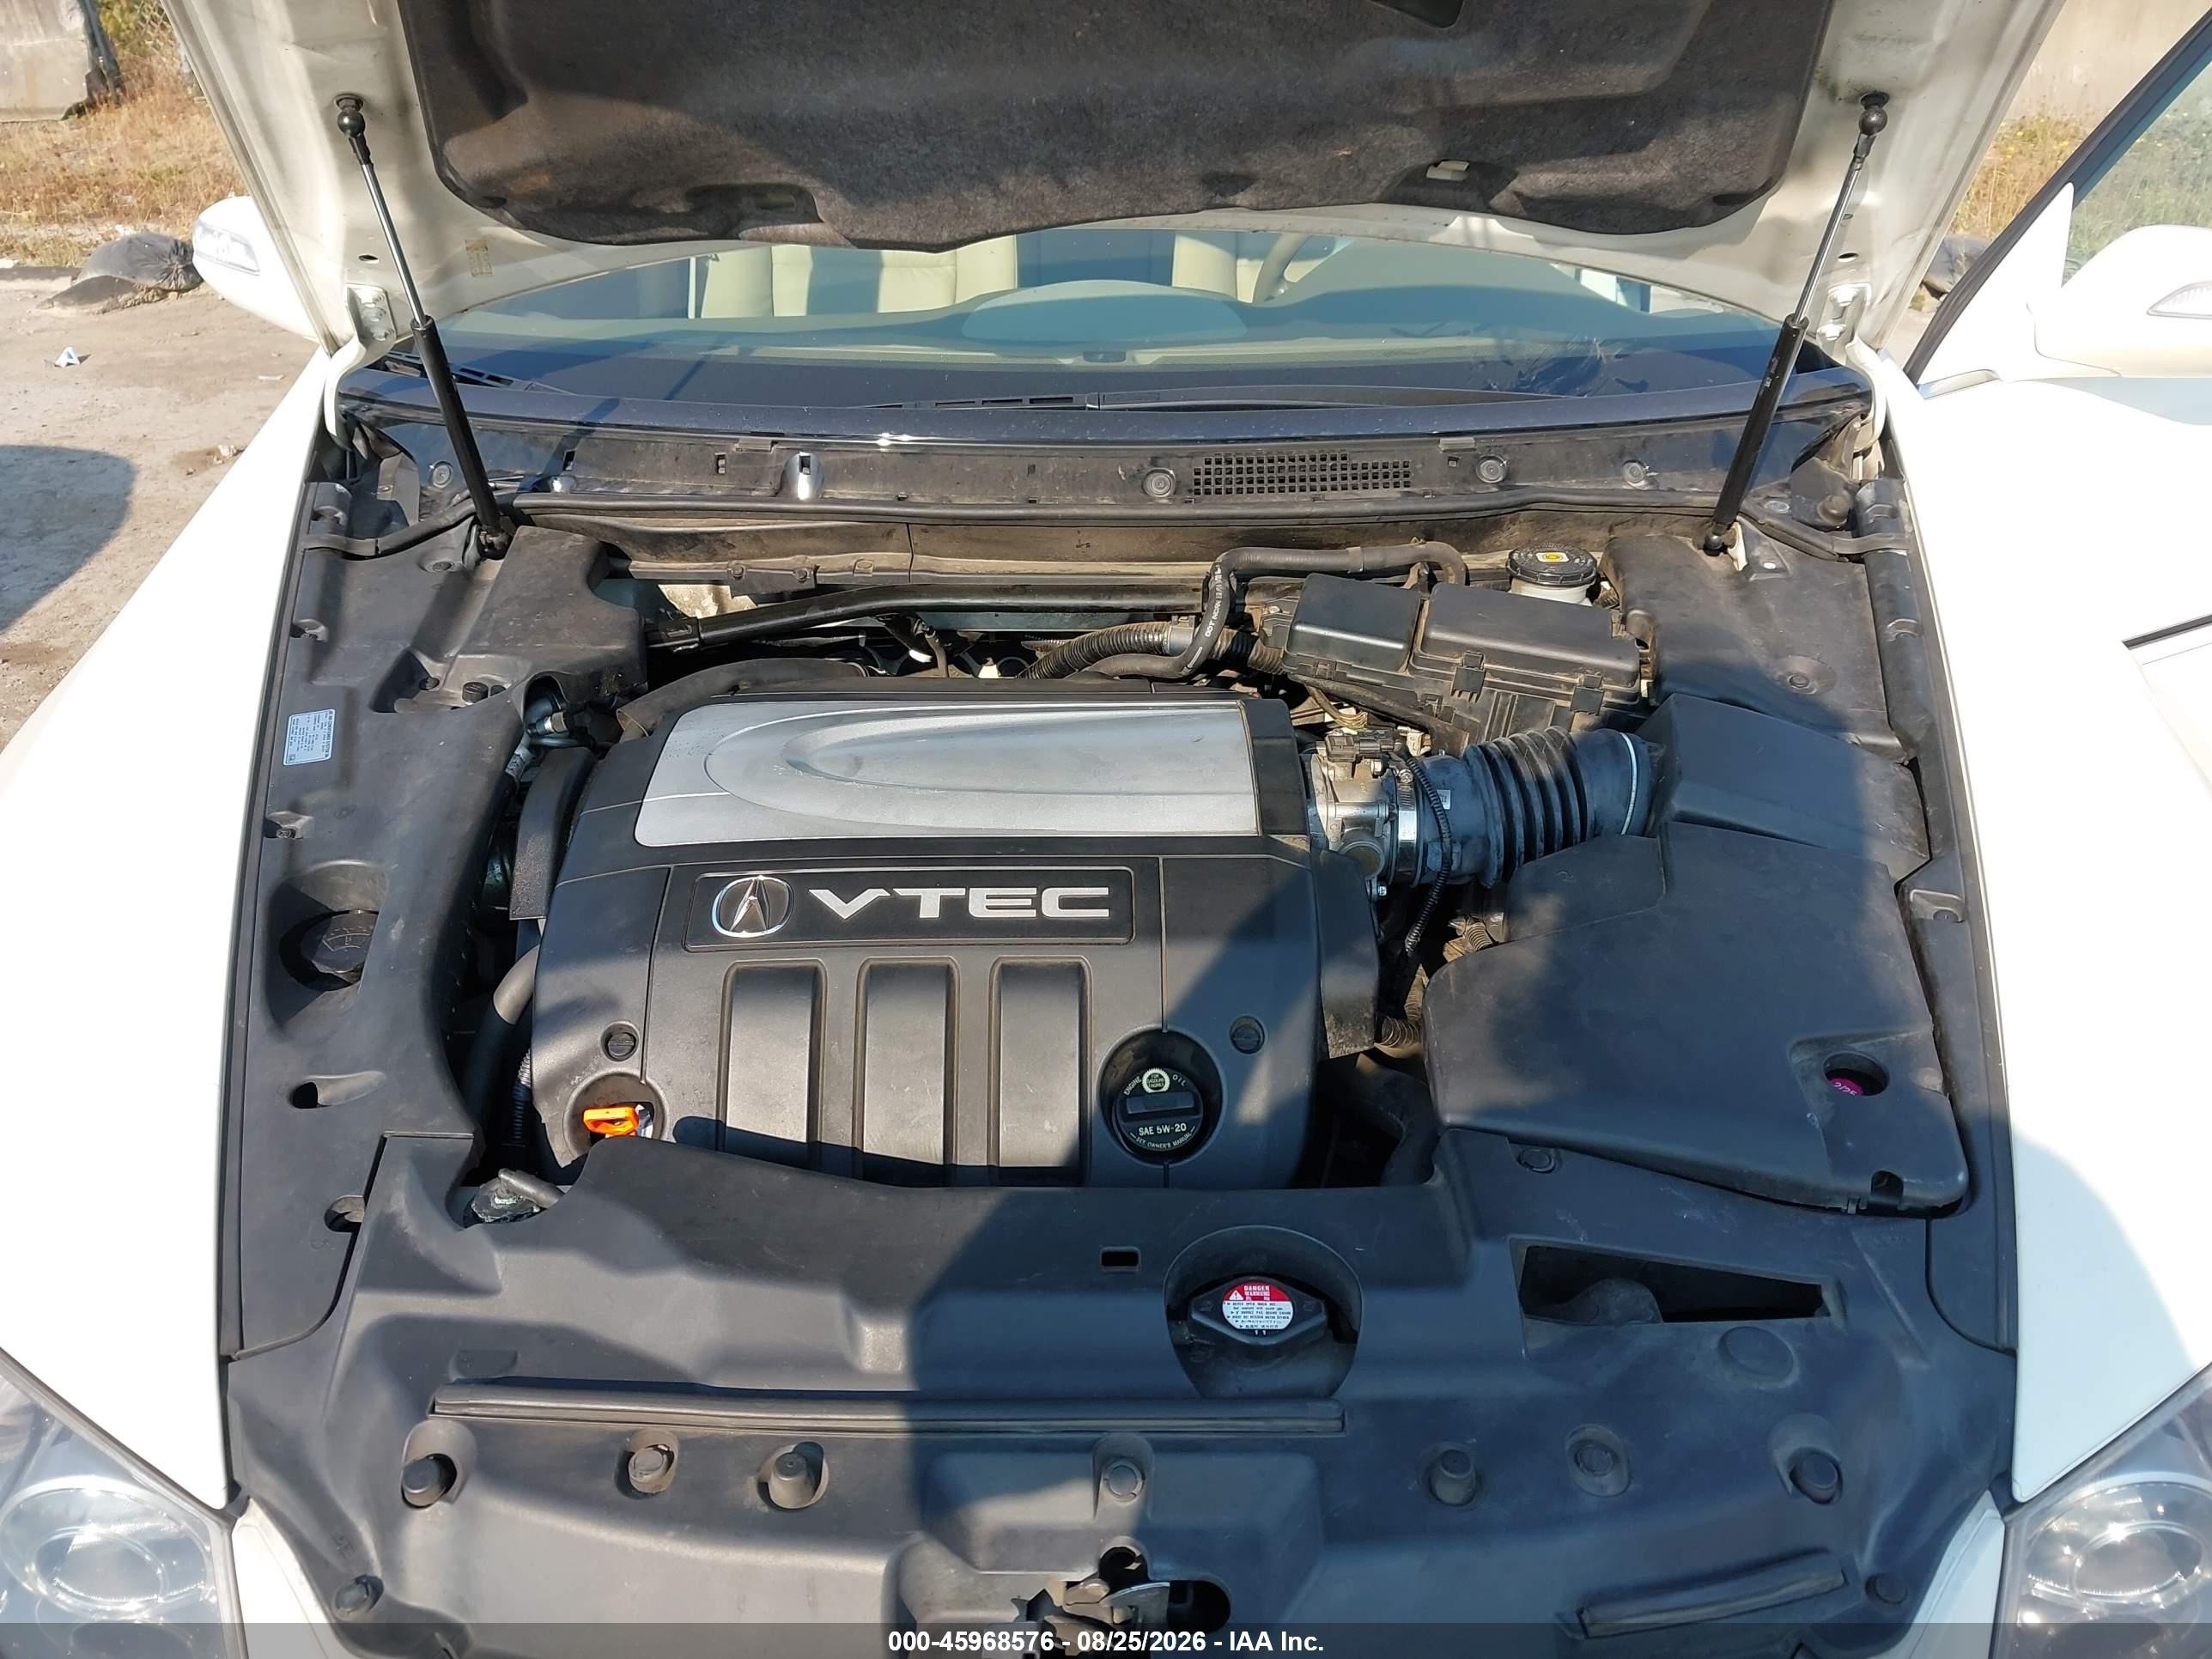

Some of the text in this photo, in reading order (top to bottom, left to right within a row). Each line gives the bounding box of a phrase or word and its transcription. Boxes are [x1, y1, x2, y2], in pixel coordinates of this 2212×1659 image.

[808, 887, 1109, 920] VTEC
[1123, 1074, 1187, 1096] ENGINE OIL
[1139, 1123, 1187, 1136] SAE 5W-20
